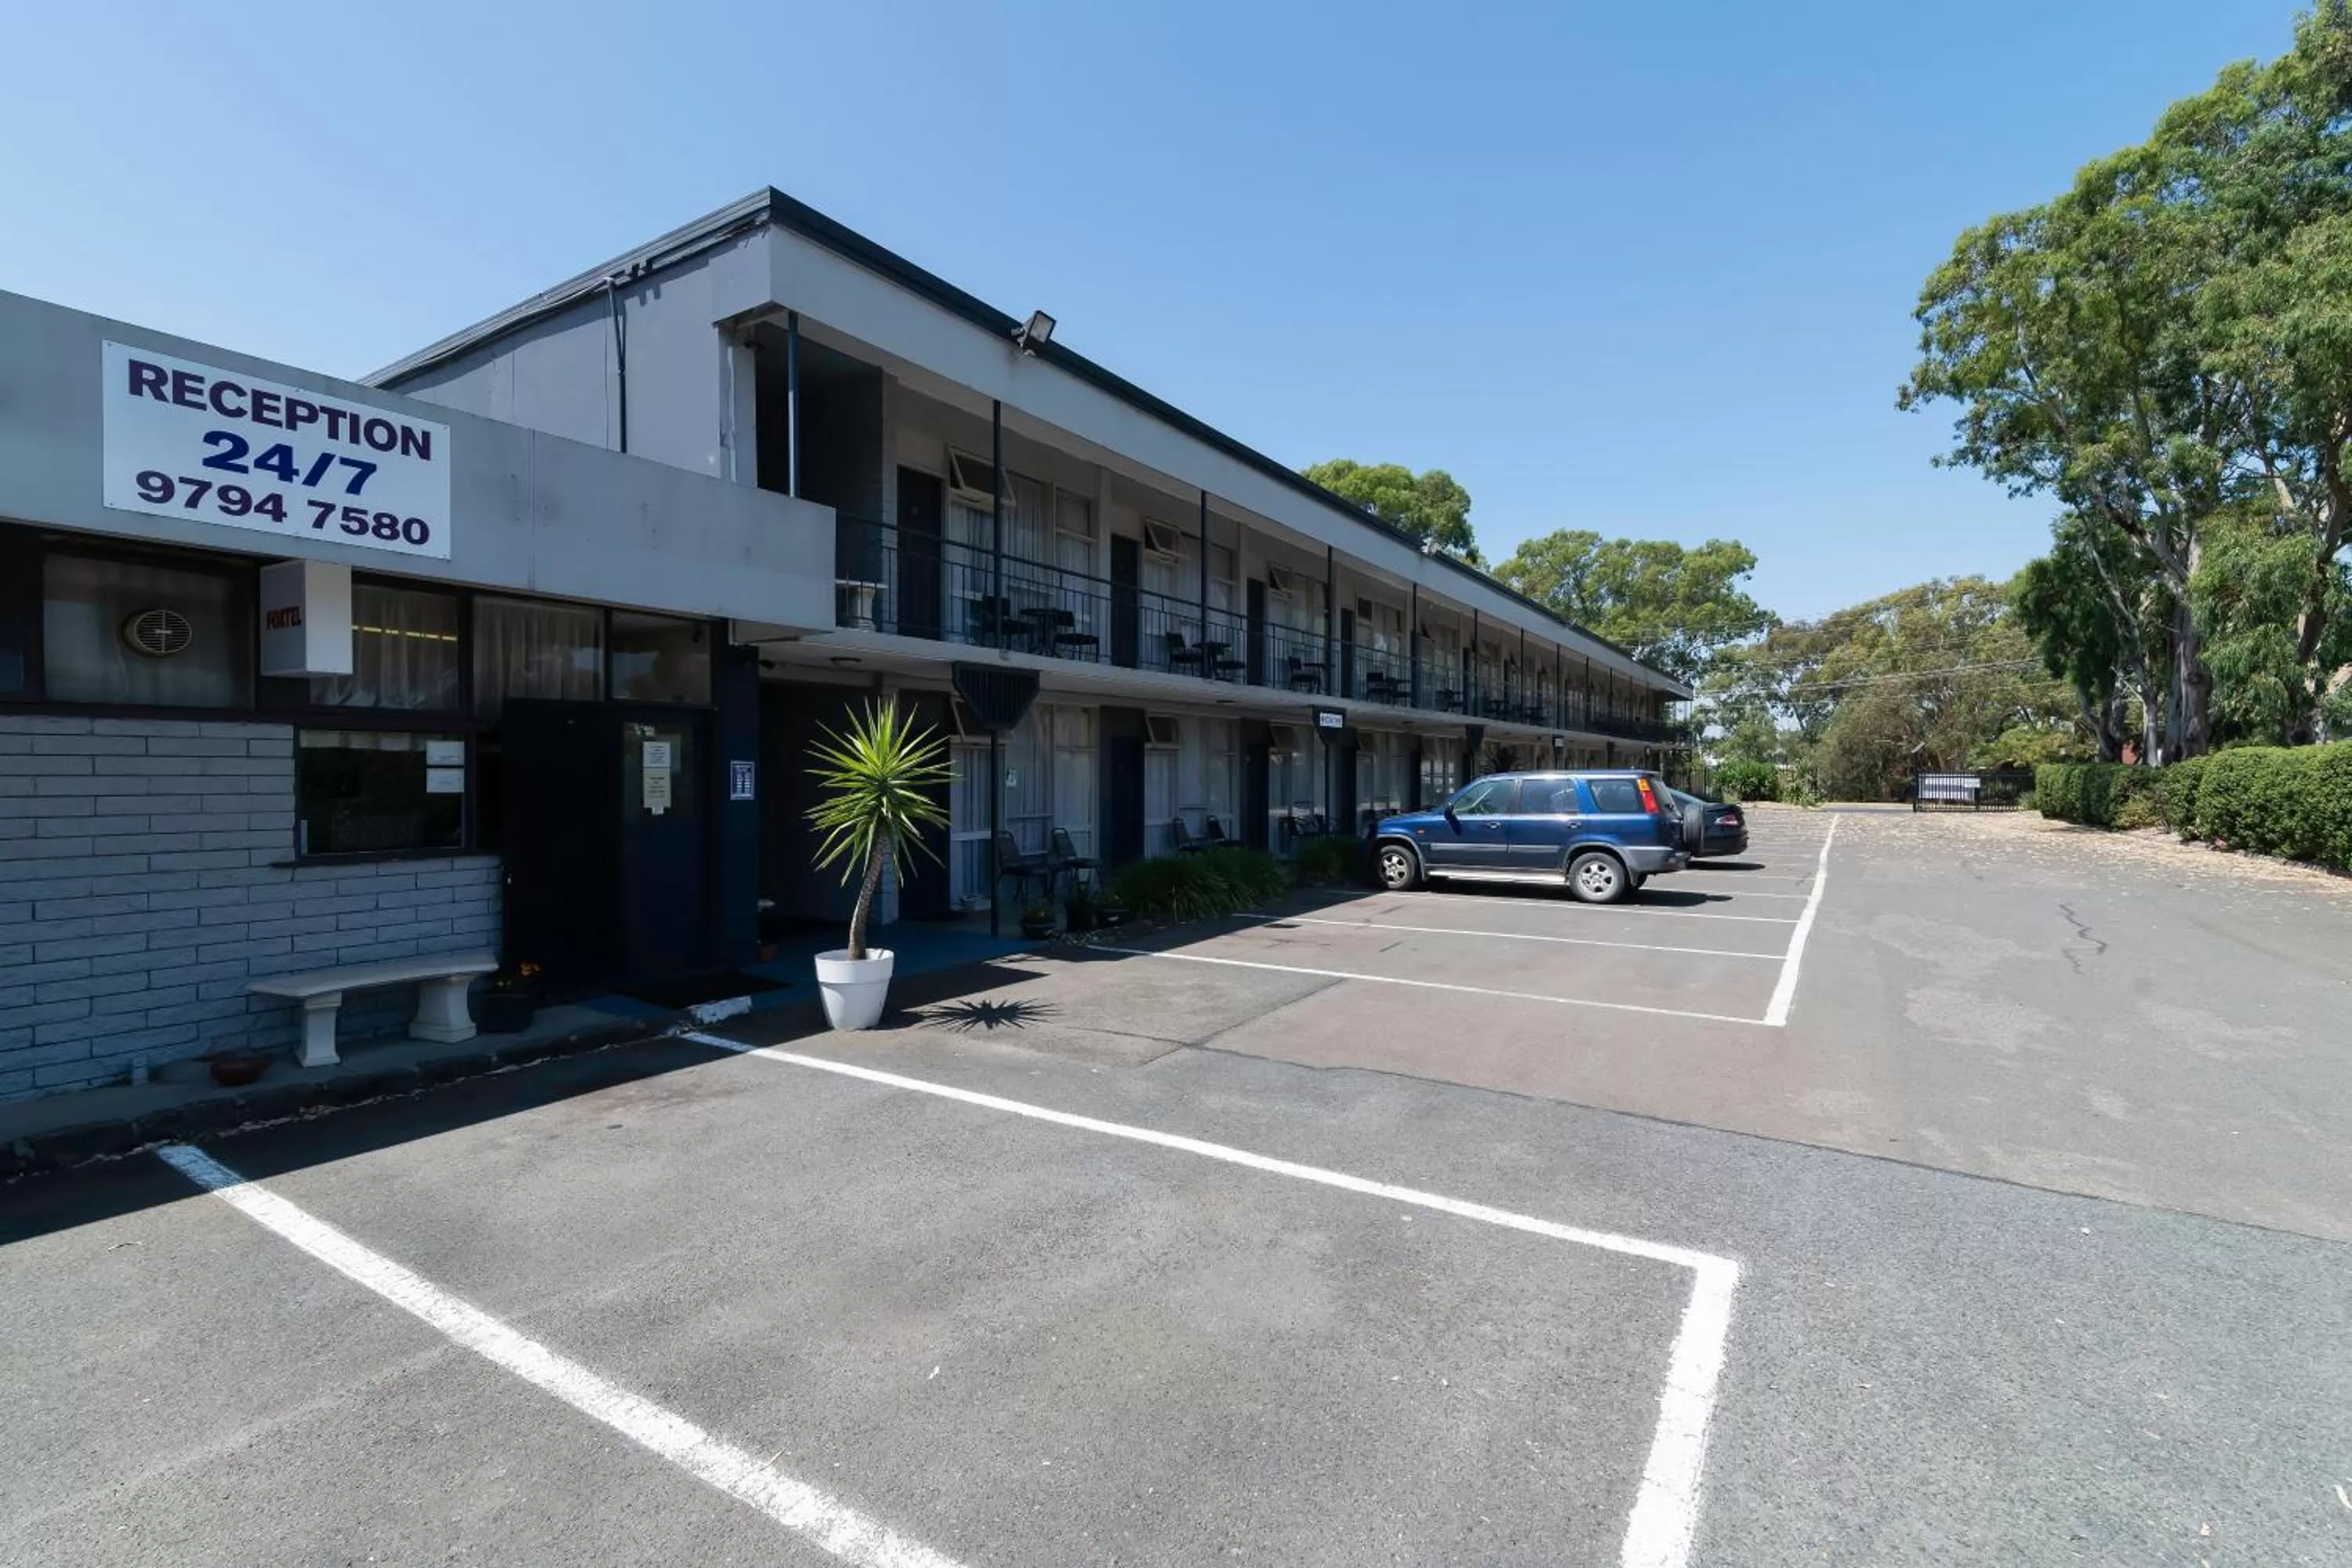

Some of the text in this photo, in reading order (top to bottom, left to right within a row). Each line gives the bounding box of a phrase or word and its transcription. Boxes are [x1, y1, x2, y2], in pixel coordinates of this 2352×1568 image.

[128, 358, 432, 462] RECEPTION
[201, 430, 378, 496] 24/7
[136, 470, 430, 546] 9794 7580
